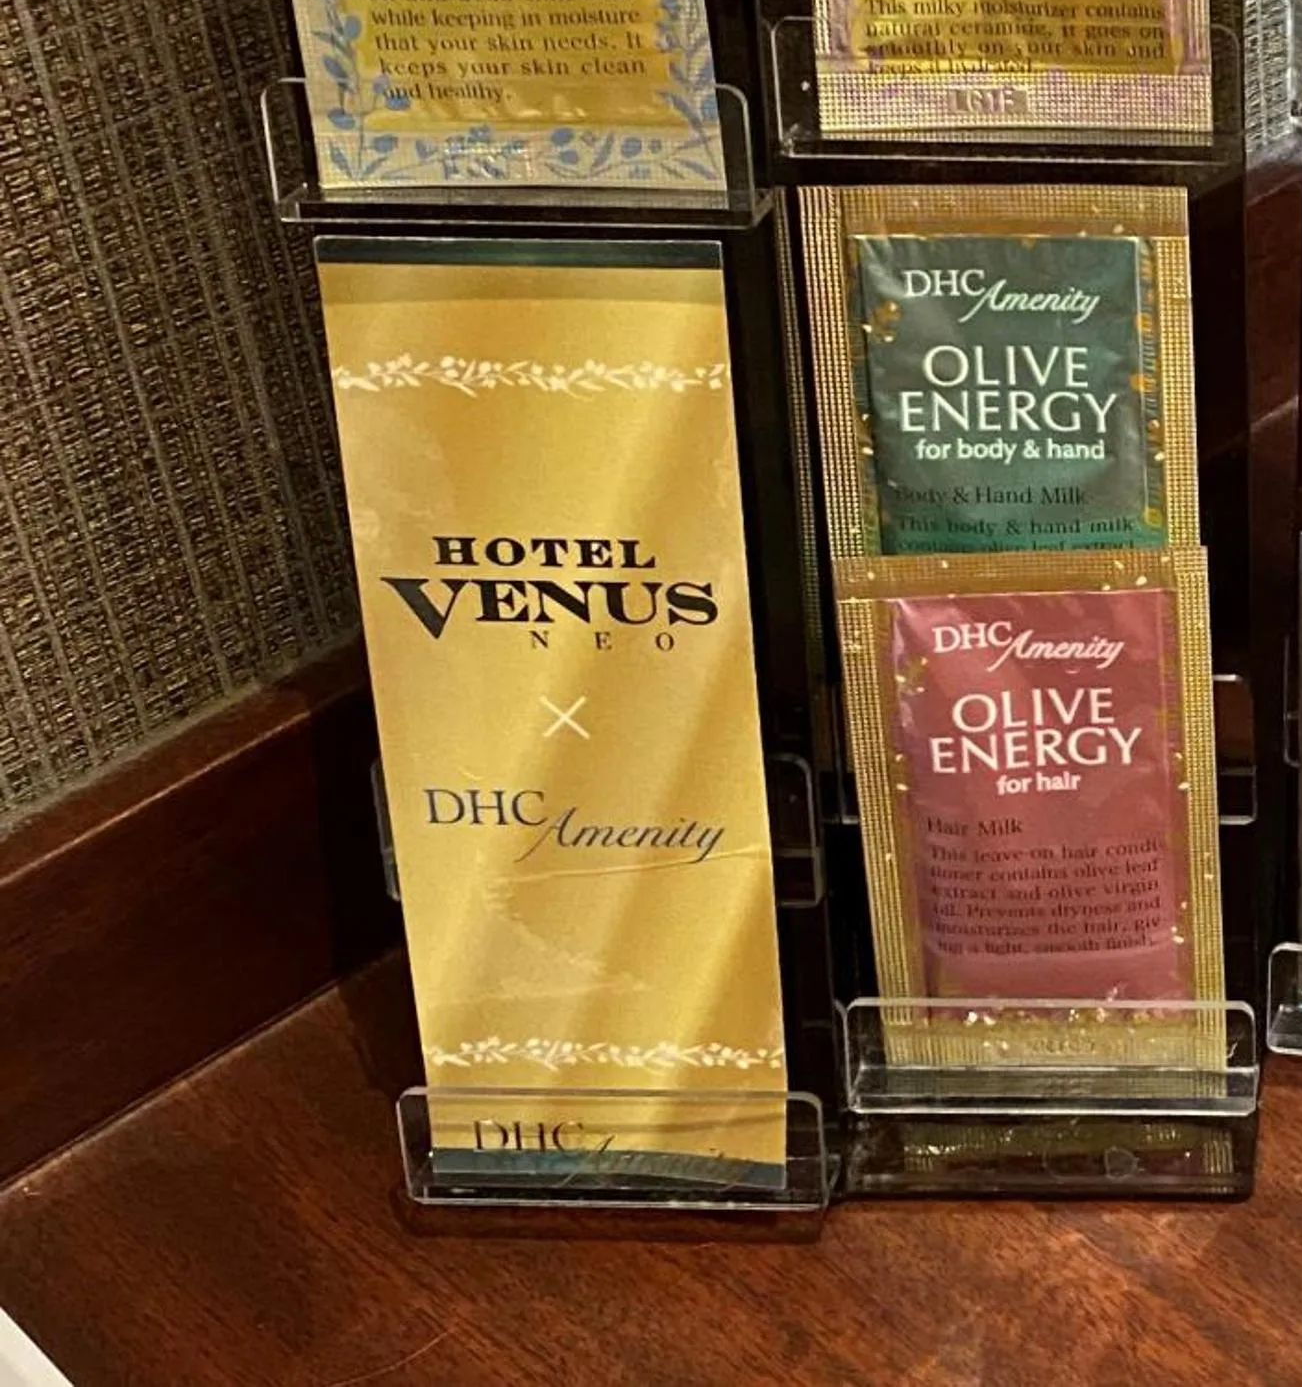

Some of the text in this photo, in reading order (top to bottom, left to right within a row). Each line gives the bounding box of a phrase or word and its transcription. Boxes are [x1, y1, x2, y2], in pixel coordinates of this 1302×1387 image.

[902, 269, 1100, 324] DHC Amenity
[922, 345, 1089, 387] OLIVE
[900, 391, 1118, 433] ENERGY
[915, 439, 1104, 464] for body & hand
[953, 488, 968, 503] &
[976, 485, 1032, 503] Hand
[1040, 487, 1089, 505] Milk
[433, 536, 656, 568] HOTEL
[380, 577, 718, 640] VENUS
[531, 630, 674, 651] NEO
[932, 622, 1125, 672] DHC Amenity
[952, 688, 1115, 732] OLIVE
[930, 727, 1142, 774] ENERGY
[997, 772, 1081, 795] for hair
[425, 788, 725, 864] DHC Amenity
[927, 817, 1023, 836] Hair Milk
